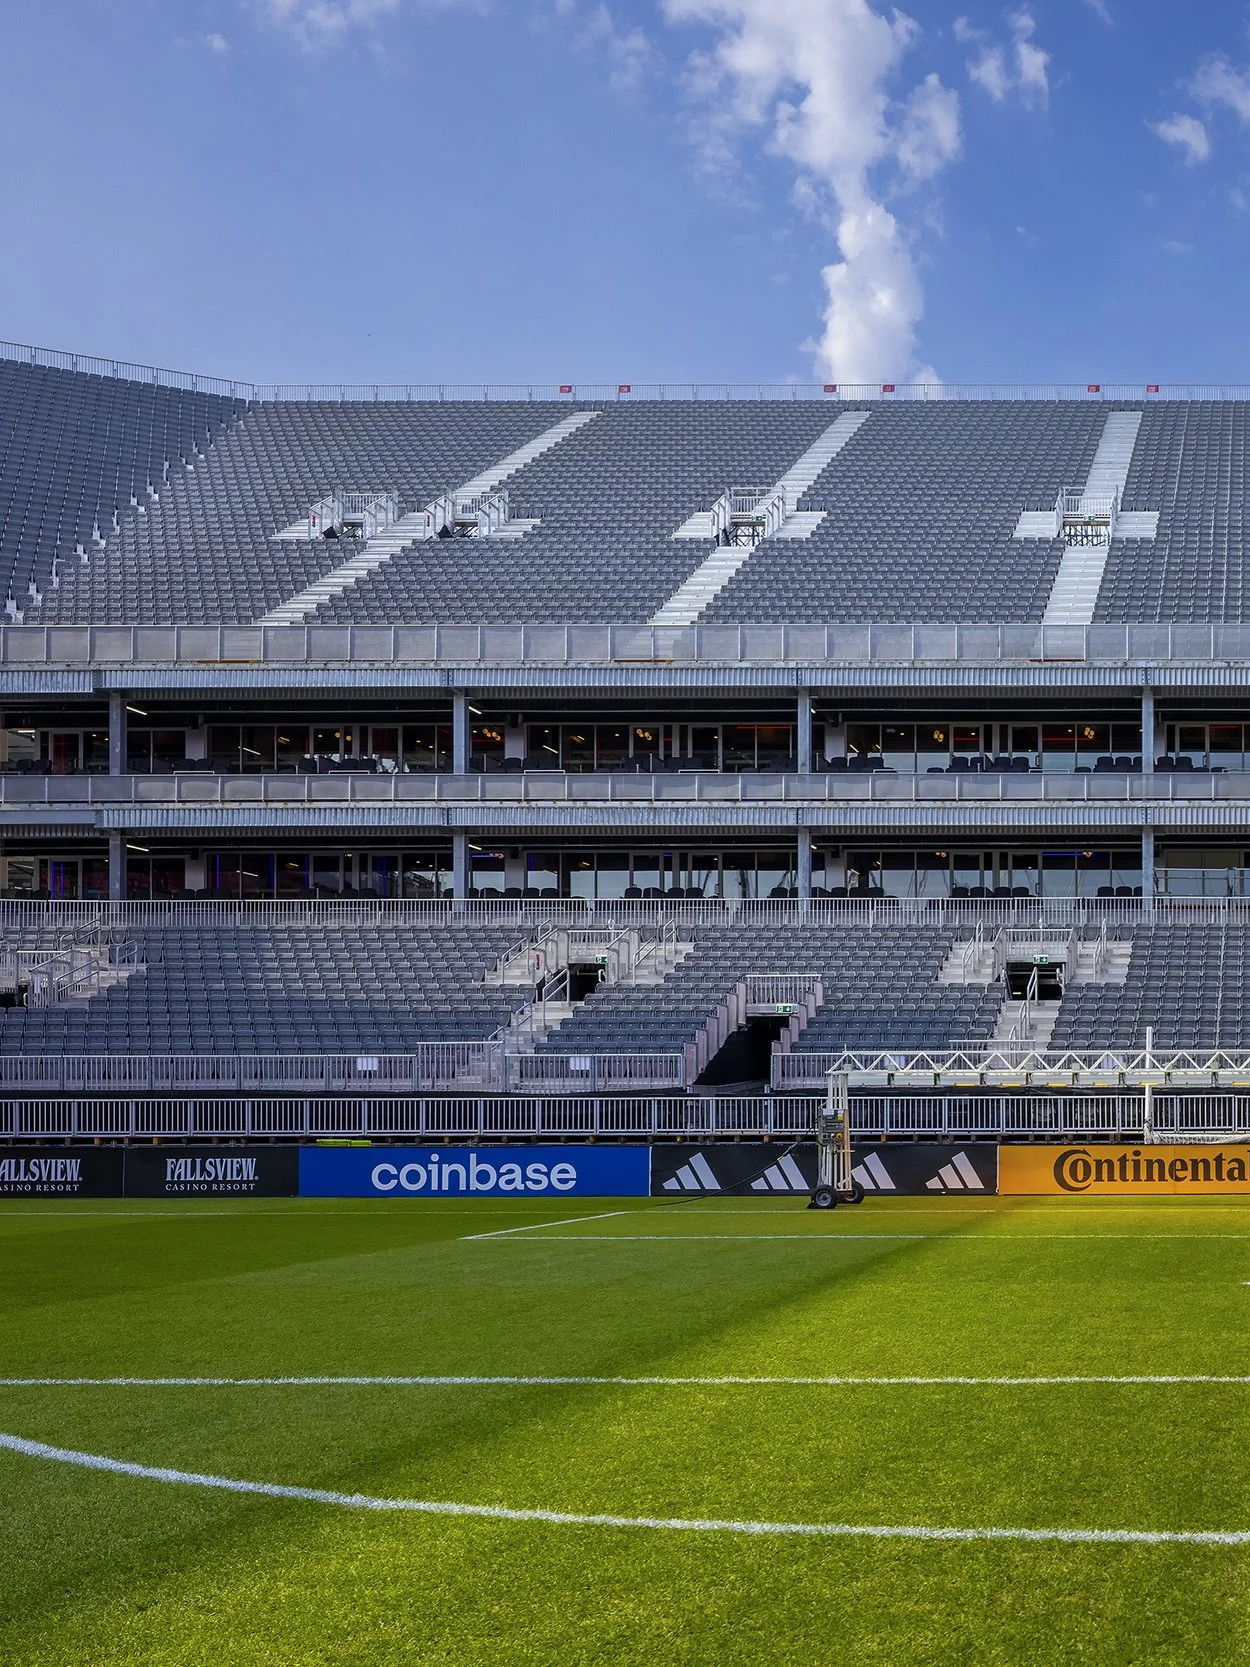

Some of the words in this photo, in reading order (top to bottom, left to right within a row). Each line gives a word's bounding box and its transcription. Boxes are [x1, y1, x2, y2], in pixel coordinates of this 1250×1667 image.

[0, 1159, 81, 1181] ALLSVIEW
[165, 1158, 257, 1181] FALLSVIEW
[371, 1153, 577, 1191] coinbase
[165, 1183, 208, 1191] CASINO
[212, 1183, 256, 1191] RESORT
